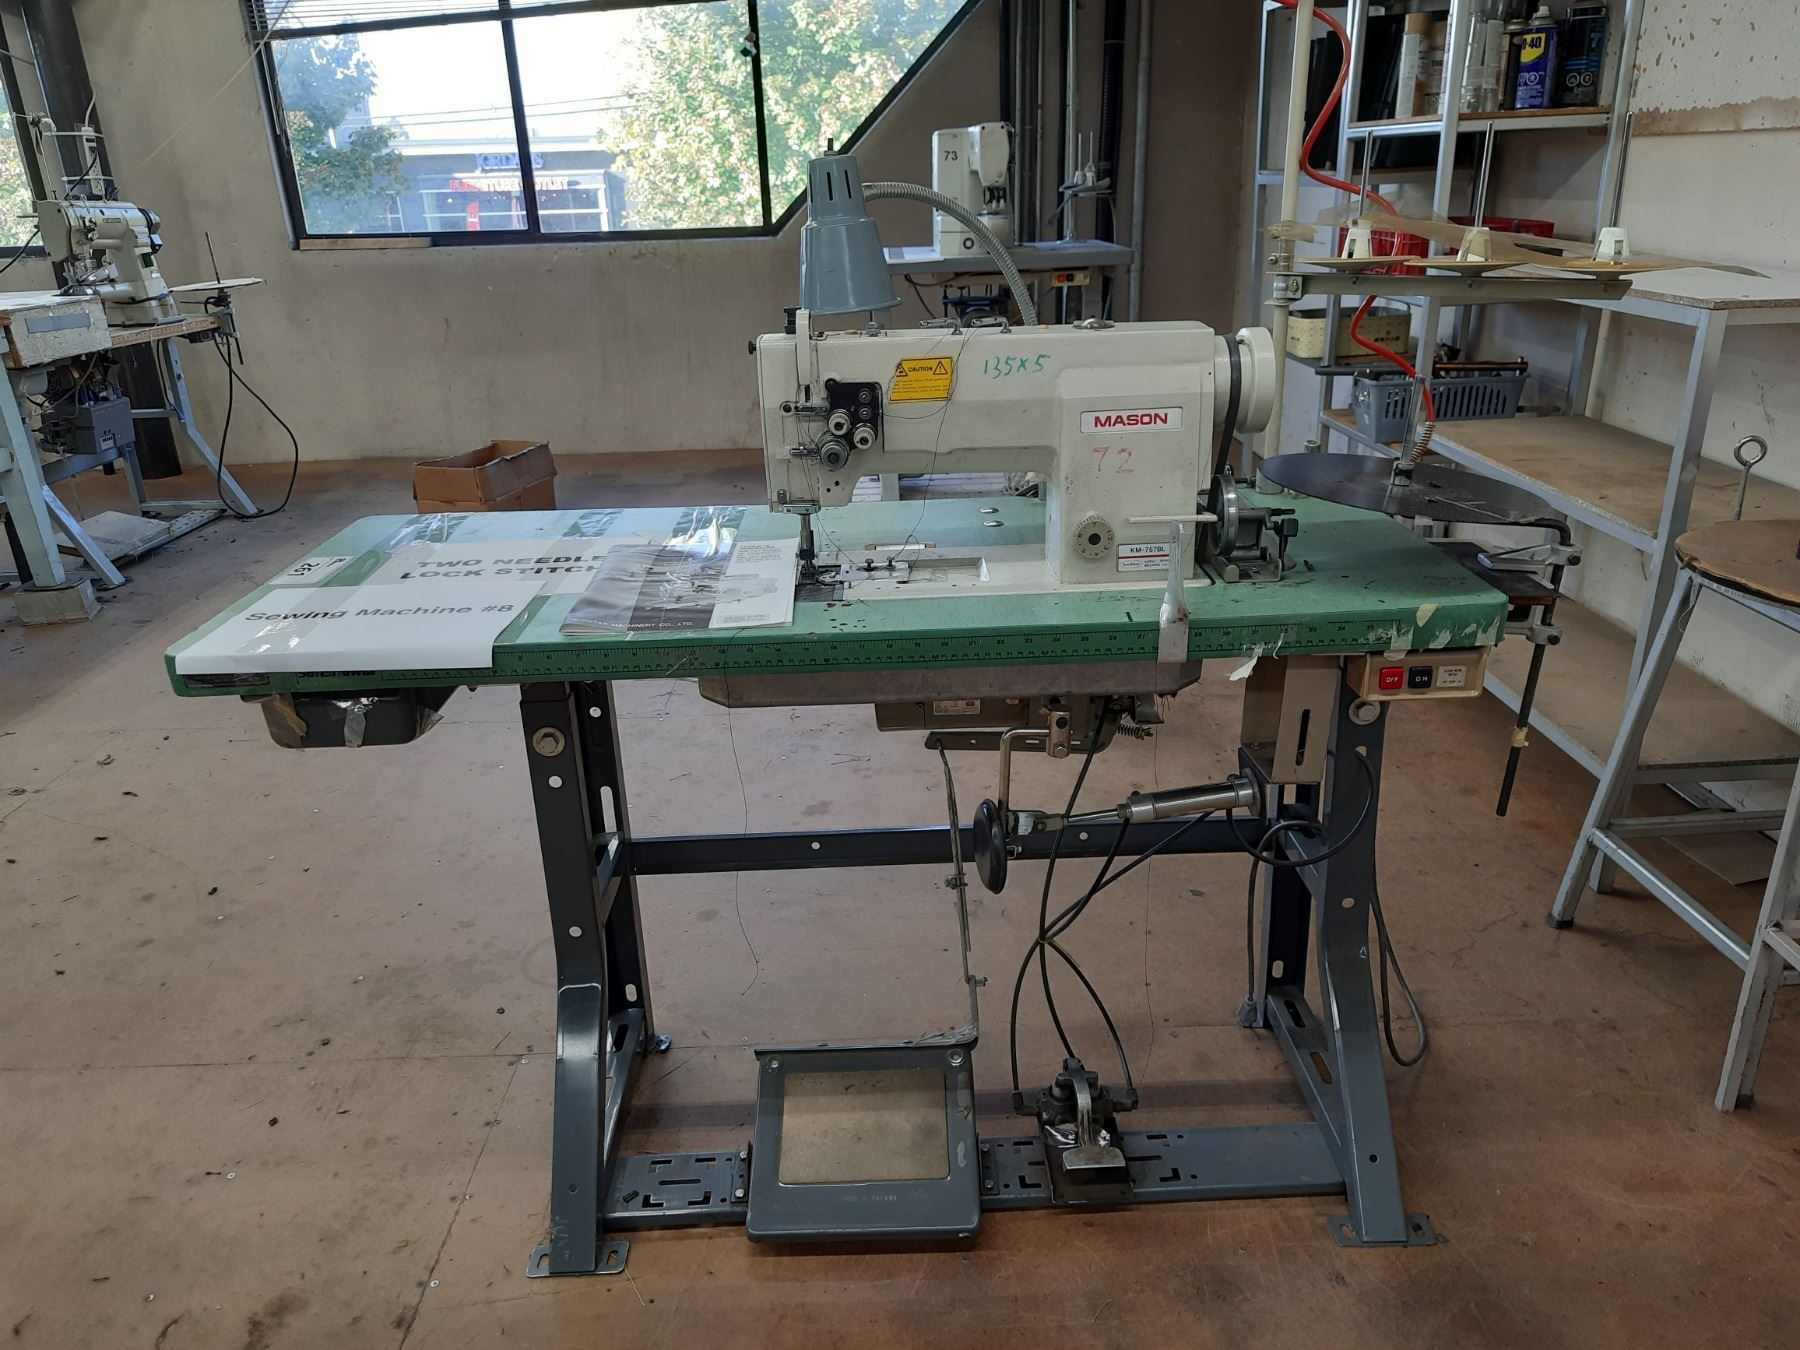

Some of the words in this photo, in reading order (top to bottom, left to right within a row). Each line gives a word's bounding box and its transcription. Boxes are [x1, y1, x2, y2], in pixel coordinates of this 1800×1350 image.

[944, 151, 958, 161] 73
[908, 365, 933, 373] CAUTION
[1094, 412, 1168, 428] MASON
[417, 559, 483, 568] TWO
[399, 569, 487, 580] LOCK
[245, 610, 348, 621] Sewing
[355, 606, 473, 616] Machine
[481, 604, 514, 613] #8
